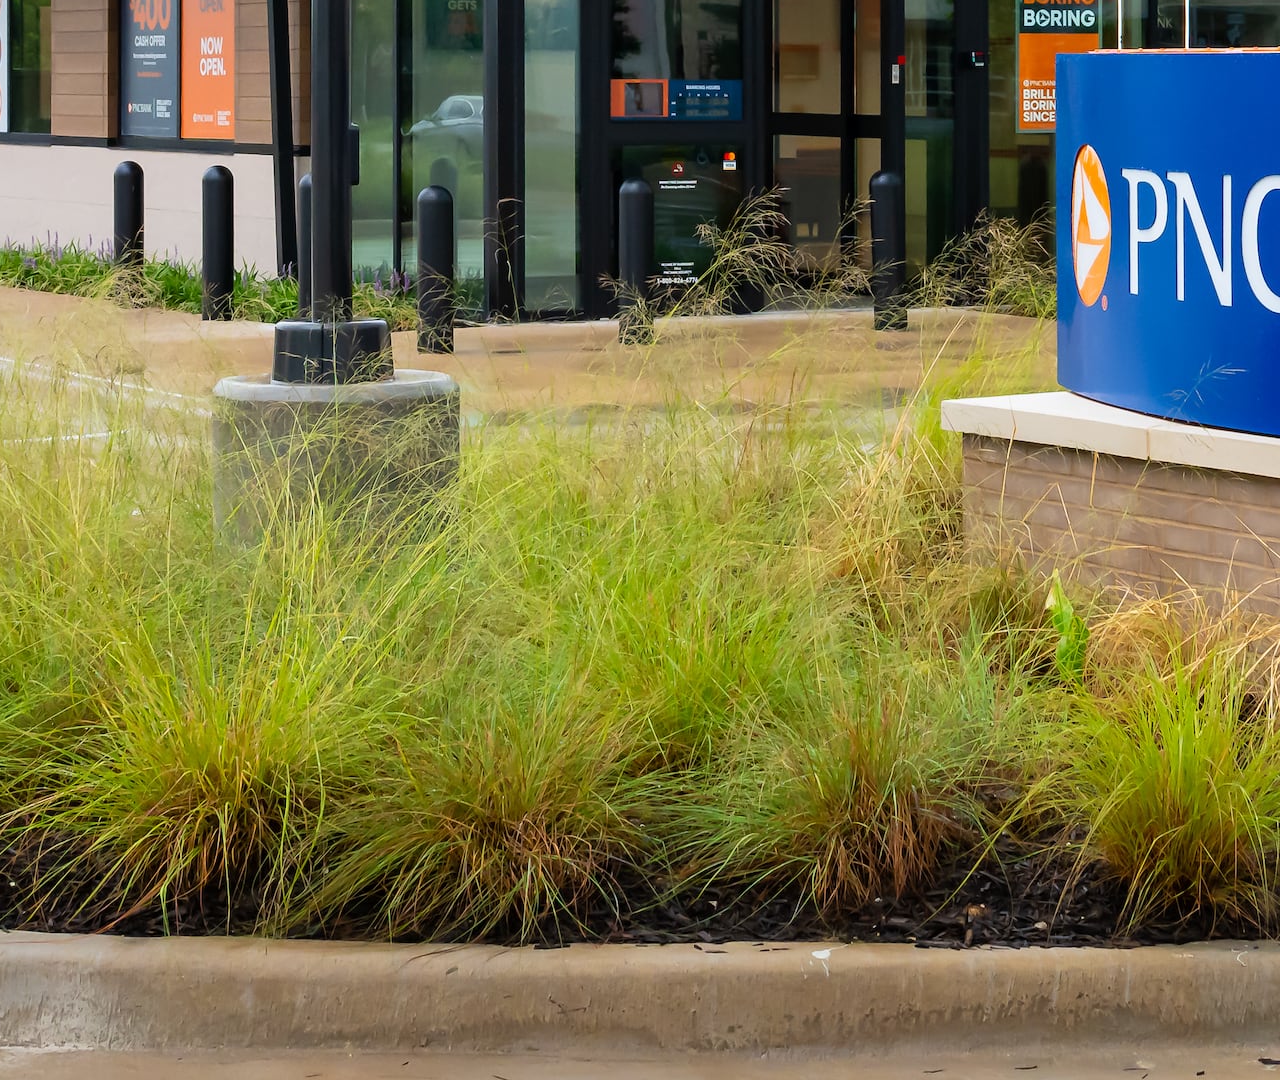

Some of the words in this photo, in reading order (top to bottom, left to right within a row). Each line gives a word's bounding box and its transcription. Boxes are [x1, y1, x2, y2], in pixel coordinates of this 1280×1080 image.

[447, 0, 477, 10] GETS
[1023, 8, 1095, 27] BORING
[1157, 18, 1173, 29] NK
[135, 35, 149, 47] CASH
[200, 36, 224, 55] NOW
[199, 57, 227, 77] OPEN.
[1023, 88, 1056, 99] BRILLI
[1023, 100, 1056, 111] BORIN
[1023, 111, 1056, 122] SINCE
